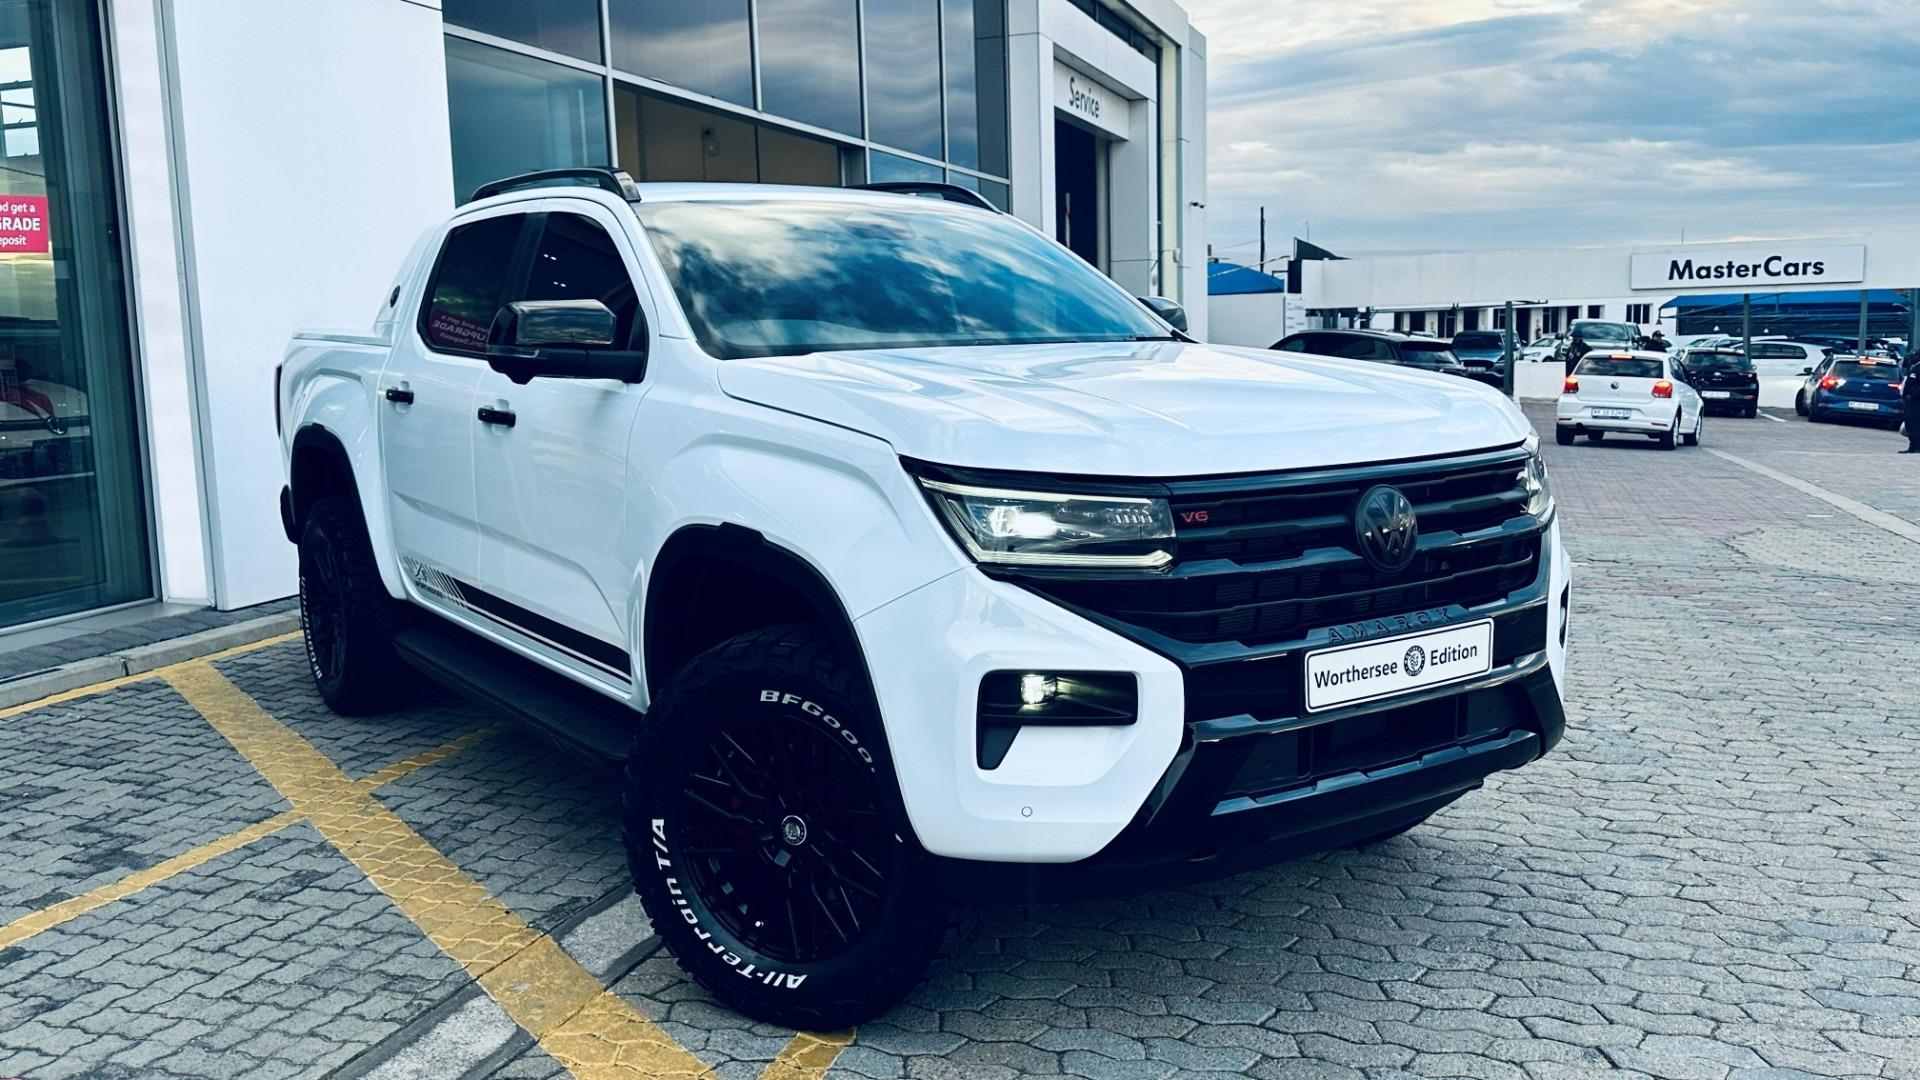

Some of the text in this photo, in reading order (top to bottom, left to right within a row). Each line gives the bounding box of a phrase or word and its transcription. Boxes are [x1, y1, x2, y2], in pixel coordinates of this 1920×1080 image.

[1069, 76, 1099, 118] Service
[10, 203, 28, 214] get
[29, 204, 36, 212] a
[1668, 255, 1825, 280] MasterCars
[1180, 510, 1209, 523] V6
[1328, 607, 1454, 644] AMAROK
[1314, 661, 1398, 689] Worthersee
[1430, 644, 1478, 666] Edition
[651, 818, 808, 989] All-Terrain T/A
